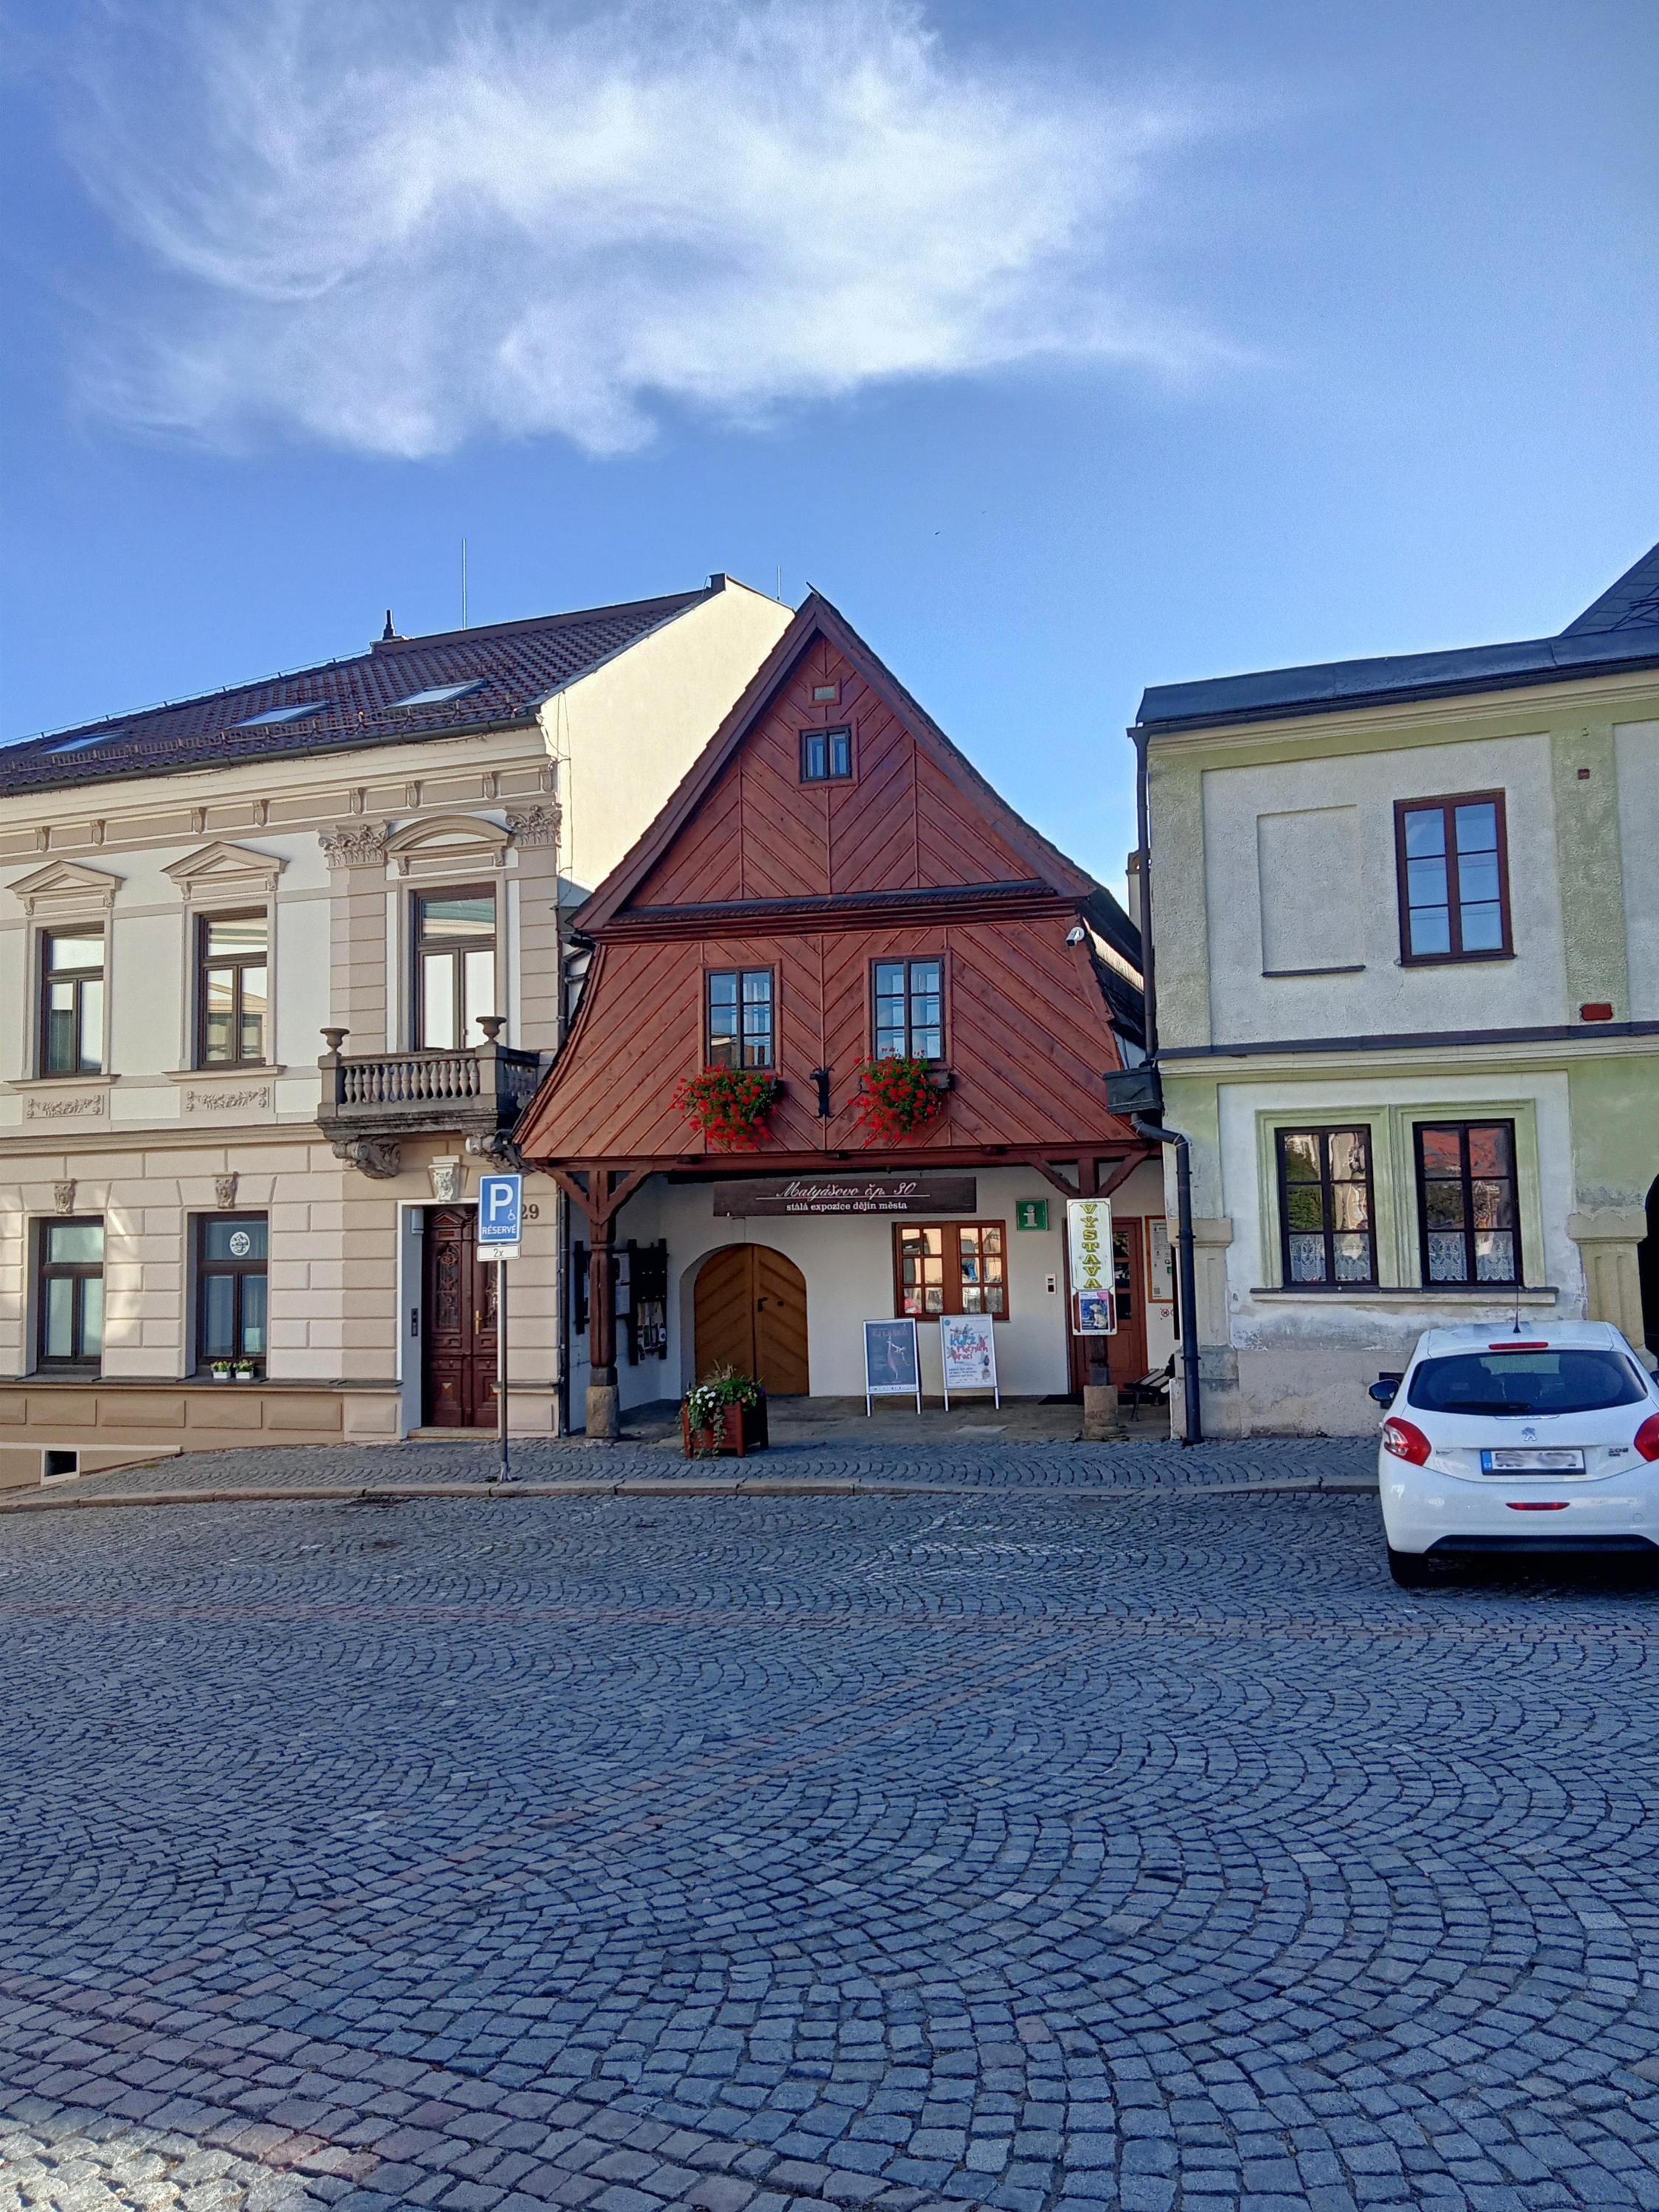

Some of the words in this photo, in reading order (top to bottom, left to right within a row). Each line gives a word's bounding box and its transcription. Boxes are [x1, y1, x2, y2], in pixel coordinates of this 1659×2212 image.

[776, 1181, 858, 1202] Matyášovo
[894, 1182, 917, 1195] 30
[490, 1183, 513, 1221] P
[786, 1202, 808, 1211] stálá
[811, 1202, 850, 1211] expozice
[853, 1201, 876, 1211] dějin
[879, 1201, 908, 1210] města
[482, 1225, 516, 1234] RÉSERVÉ
